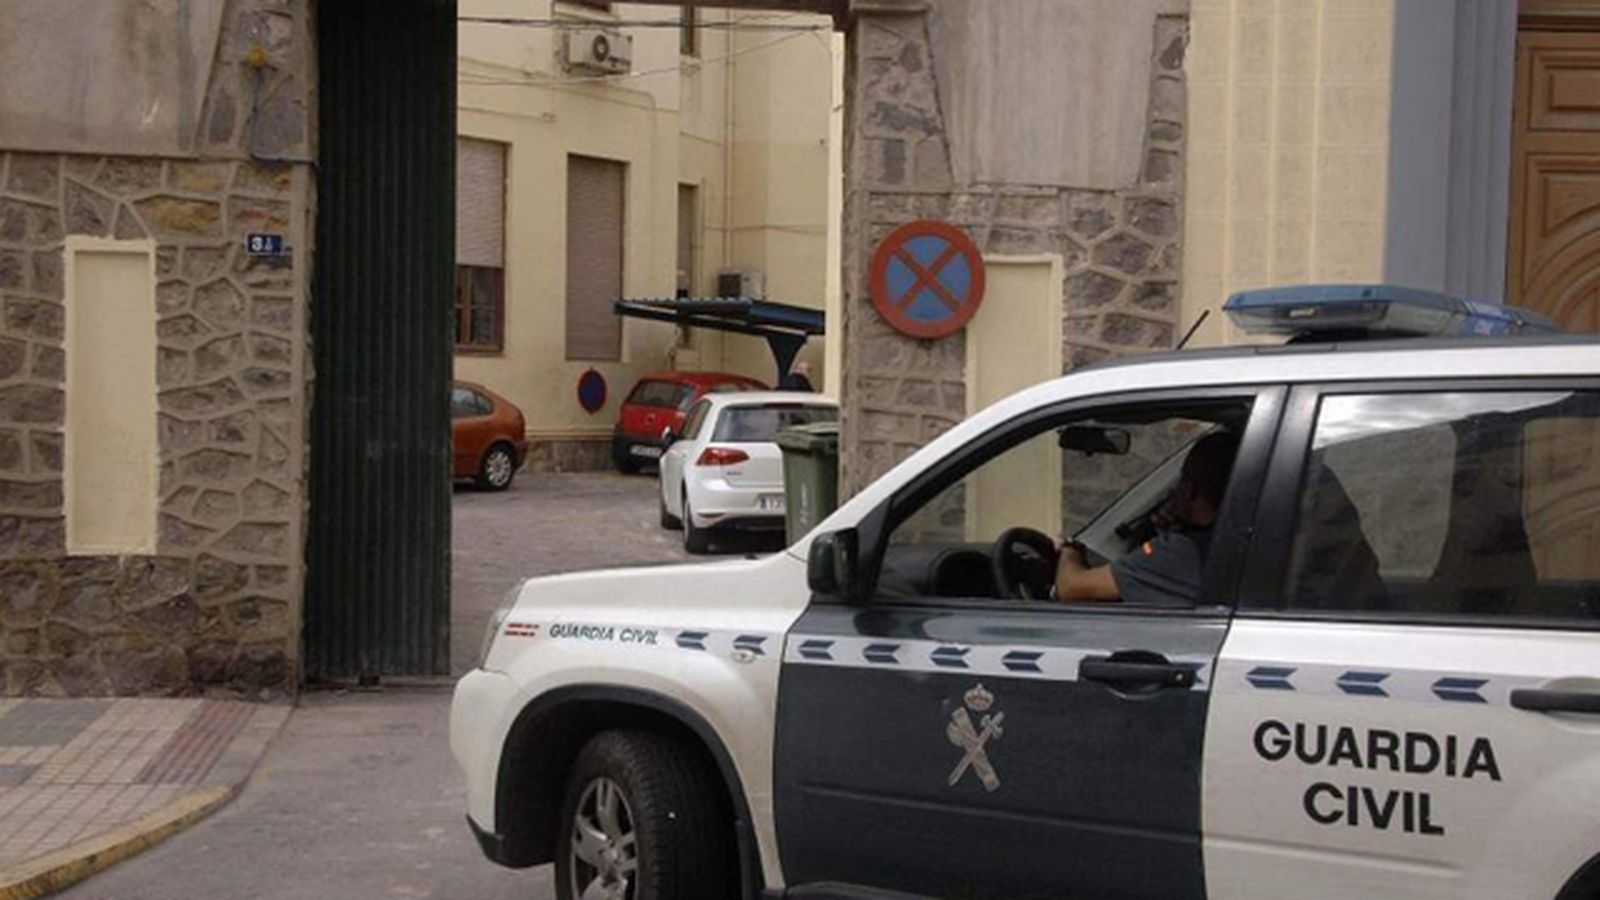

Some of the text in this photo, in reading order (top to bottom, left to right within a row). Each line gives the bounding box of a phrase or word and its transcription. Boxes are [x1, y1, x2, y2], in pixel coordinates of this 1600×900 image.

[550, 623, 614, 641] GUARDIA
[619, 628, 658, 645] CIVIL
[1253, 719, 1502, 782] GUARDIA
[1302, 782, 1445, 836] CIVIL
